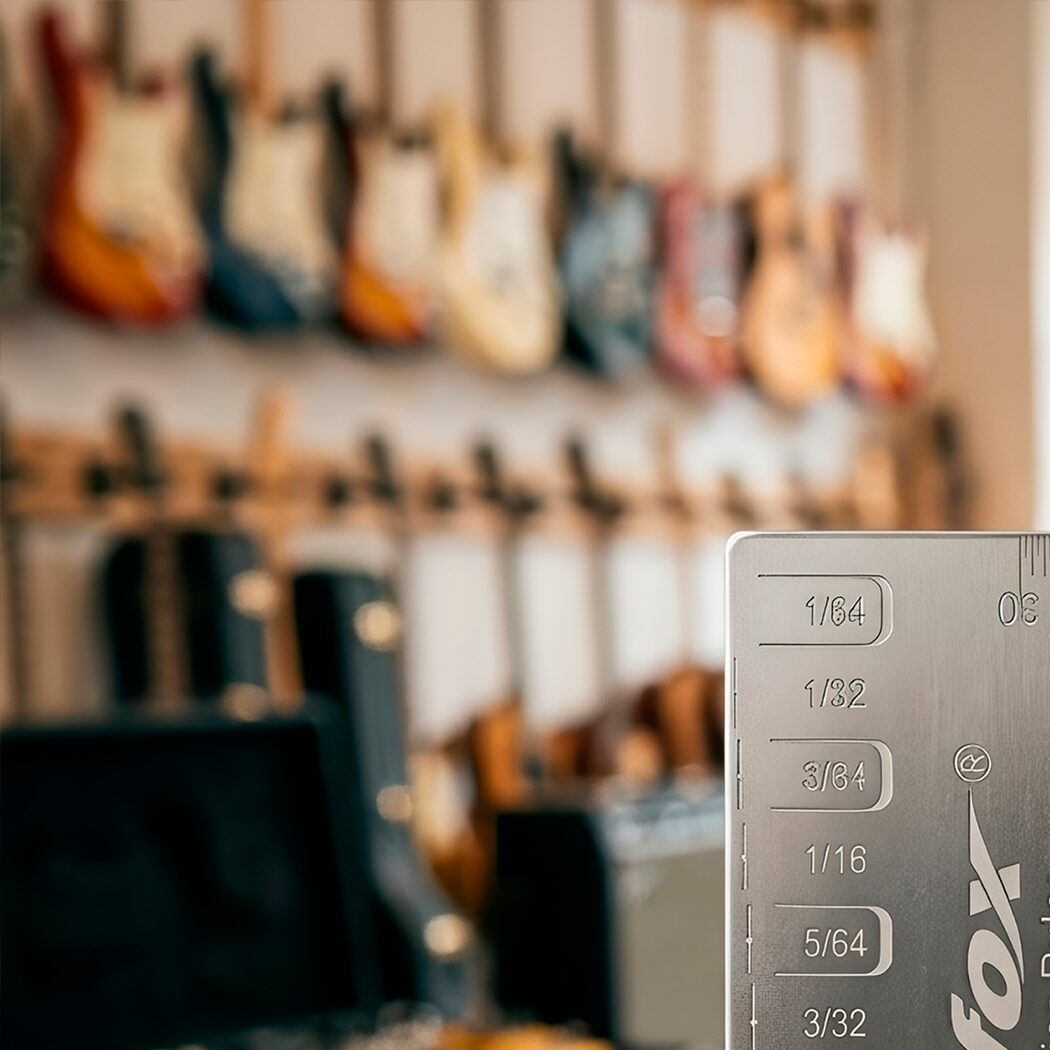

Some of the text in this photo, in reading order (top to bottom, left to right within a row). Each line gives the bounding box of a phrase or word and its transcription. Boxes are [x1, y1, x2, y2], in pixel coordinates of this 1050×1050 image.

[805, 844, 867, 875] 1/16
[804, 928, 868, 958] 5/64
[803, 1008, 867, 1038] 3/32
